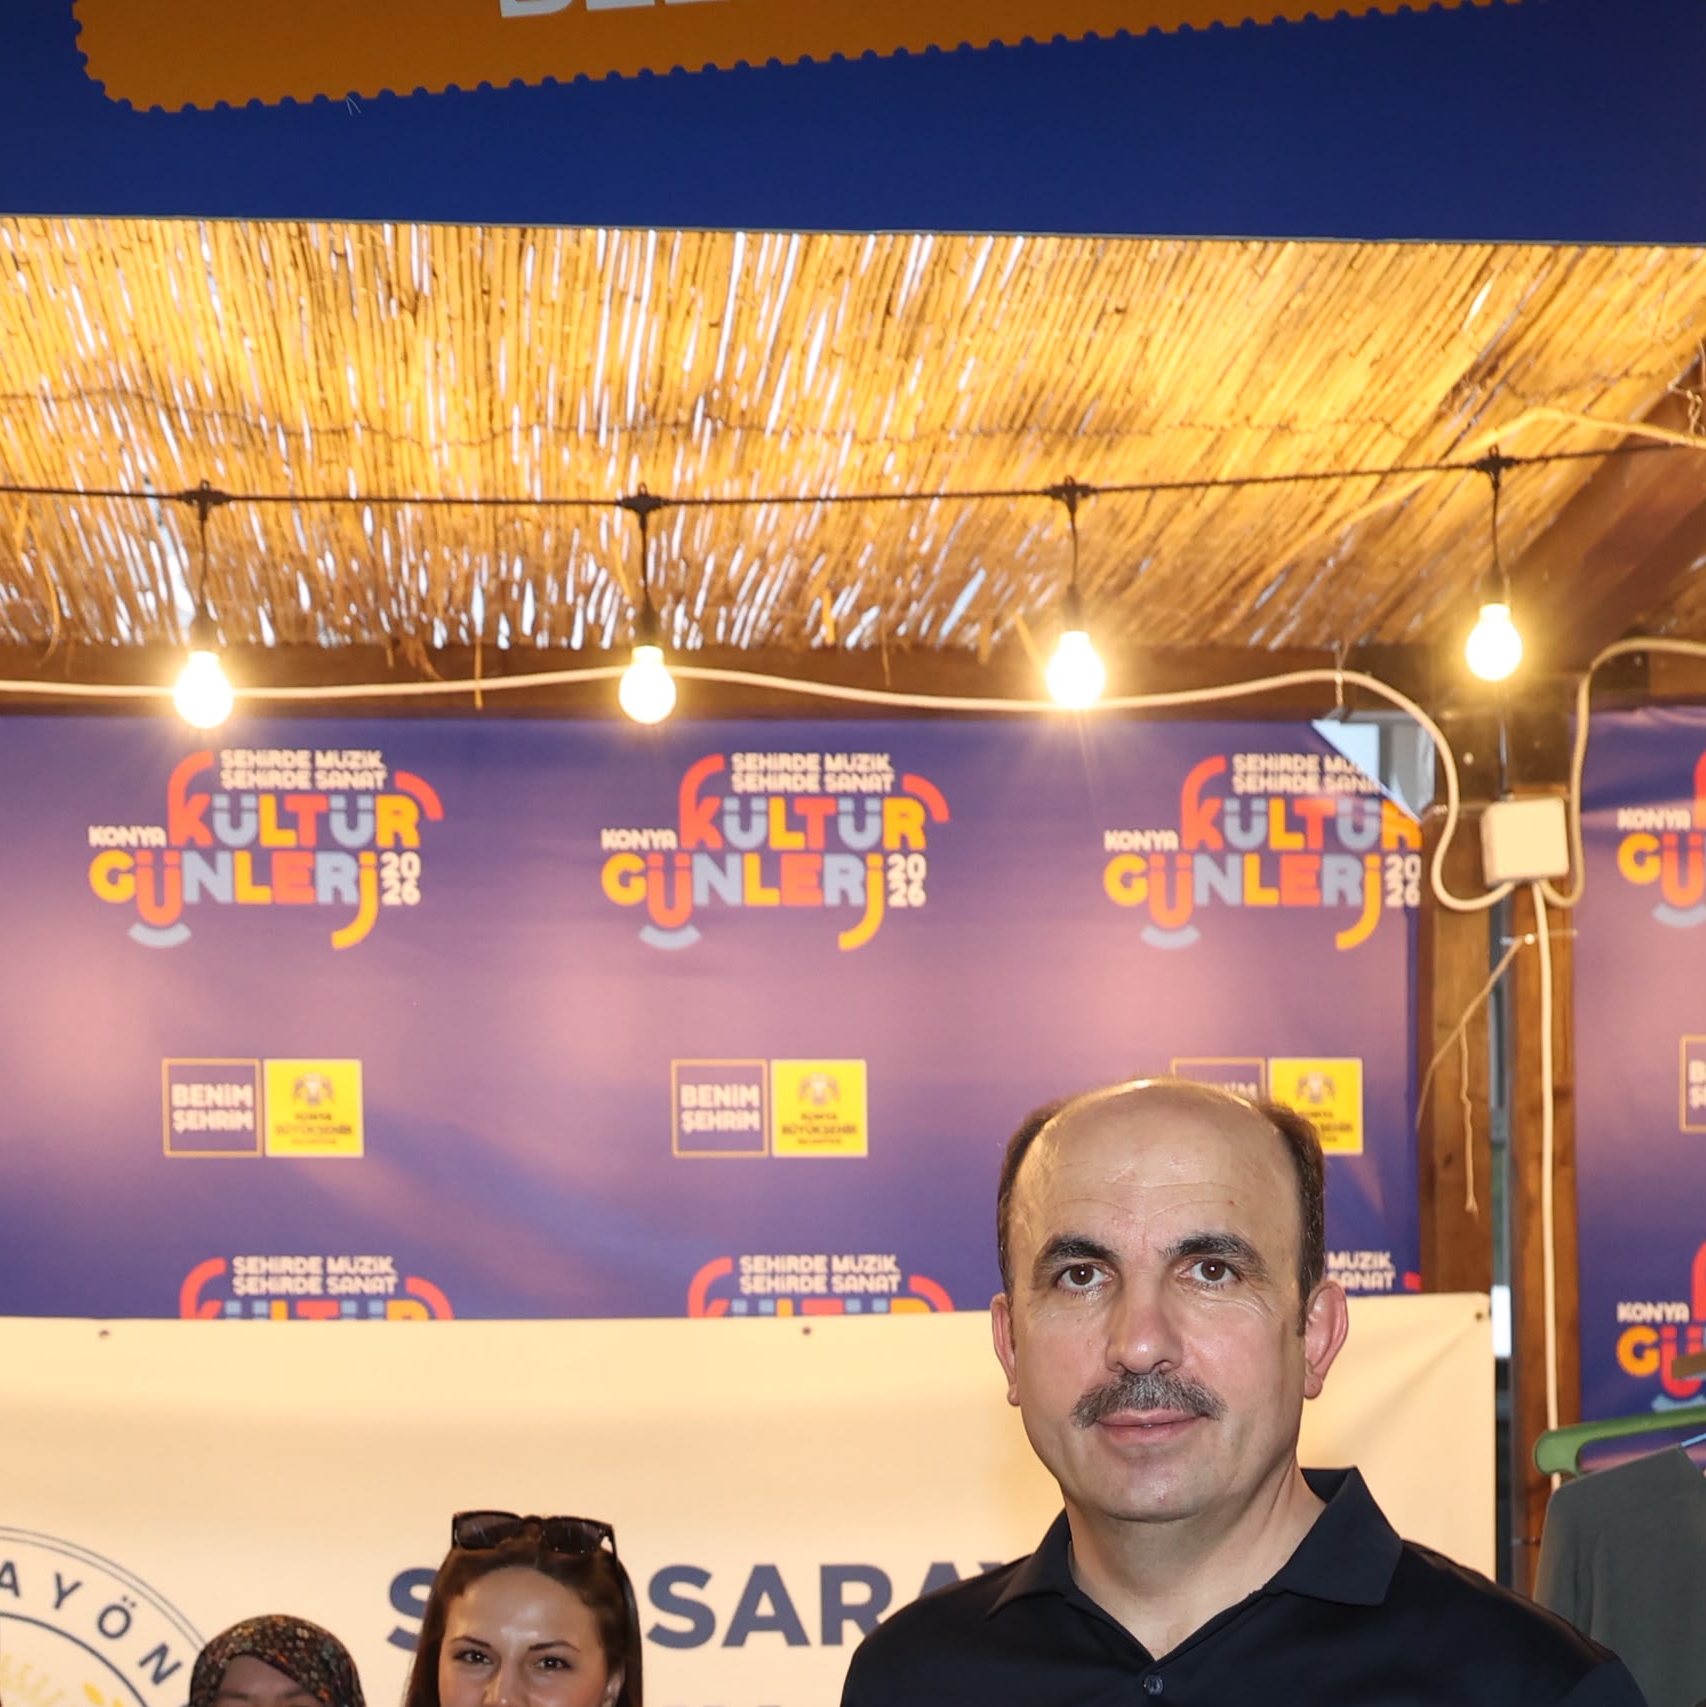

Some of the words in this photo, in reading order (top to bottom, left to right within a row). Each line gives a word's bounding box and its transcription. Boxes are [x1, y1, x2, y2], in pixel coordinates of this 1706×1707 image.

[1323, 775, 1380, 794] SANA
[89, 825, 166, 847] KONYA
[167, 750, 420, 847] KÜLTÜR
[601, 829, 677, 850] KONYA
[679, 753, 926, 850] KÜLTÜR
[1104, 830, 1178, 851] KONYA
[1181, 755, 1422, 850] KÜLTÜR
[1617, 808, 1691, 830] KONYA
[380, 852, 421, 878] 20
[888, 854, 927, 879] 20
[1385, 854, 1421, 880] 20
[382, 878, 421, 906] 26
[888, 880, 927, 907] 26
[1385, 881, 1421, 907] 26
[1617, 1302, 1690, 1323] KONYA
